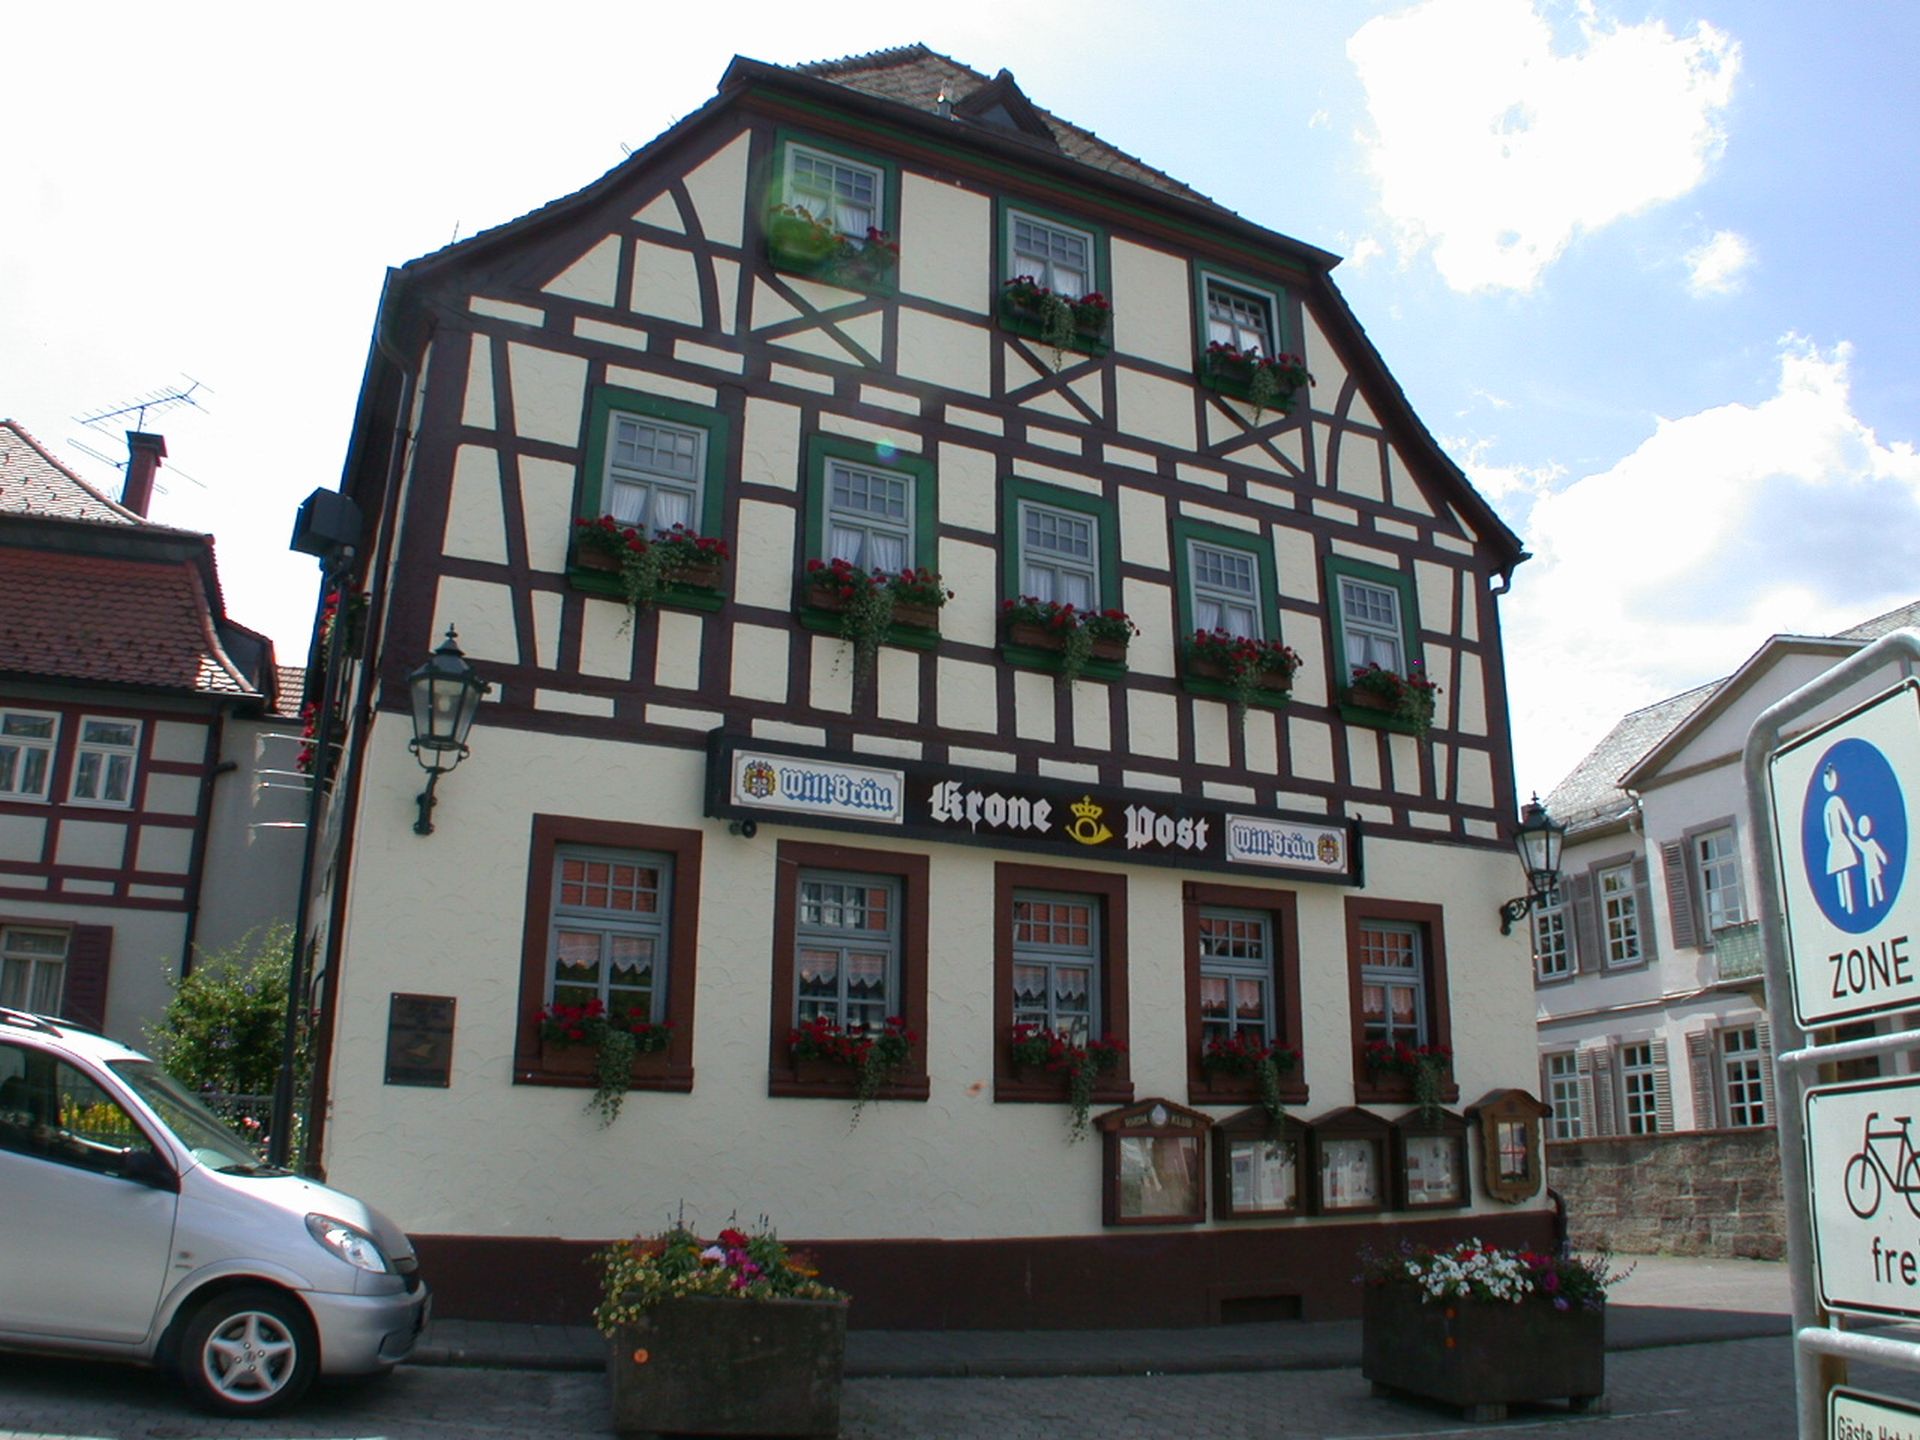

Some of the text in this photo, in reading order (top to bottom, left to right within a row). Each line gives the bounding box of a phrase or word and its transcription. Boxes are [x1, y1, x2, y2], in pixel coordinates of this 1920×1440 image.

[928, 780, 1209, 850] Krone Post
[1828, 935, 1913, 999] ZONE
[1872, 1236, 1920, 1286] fre
